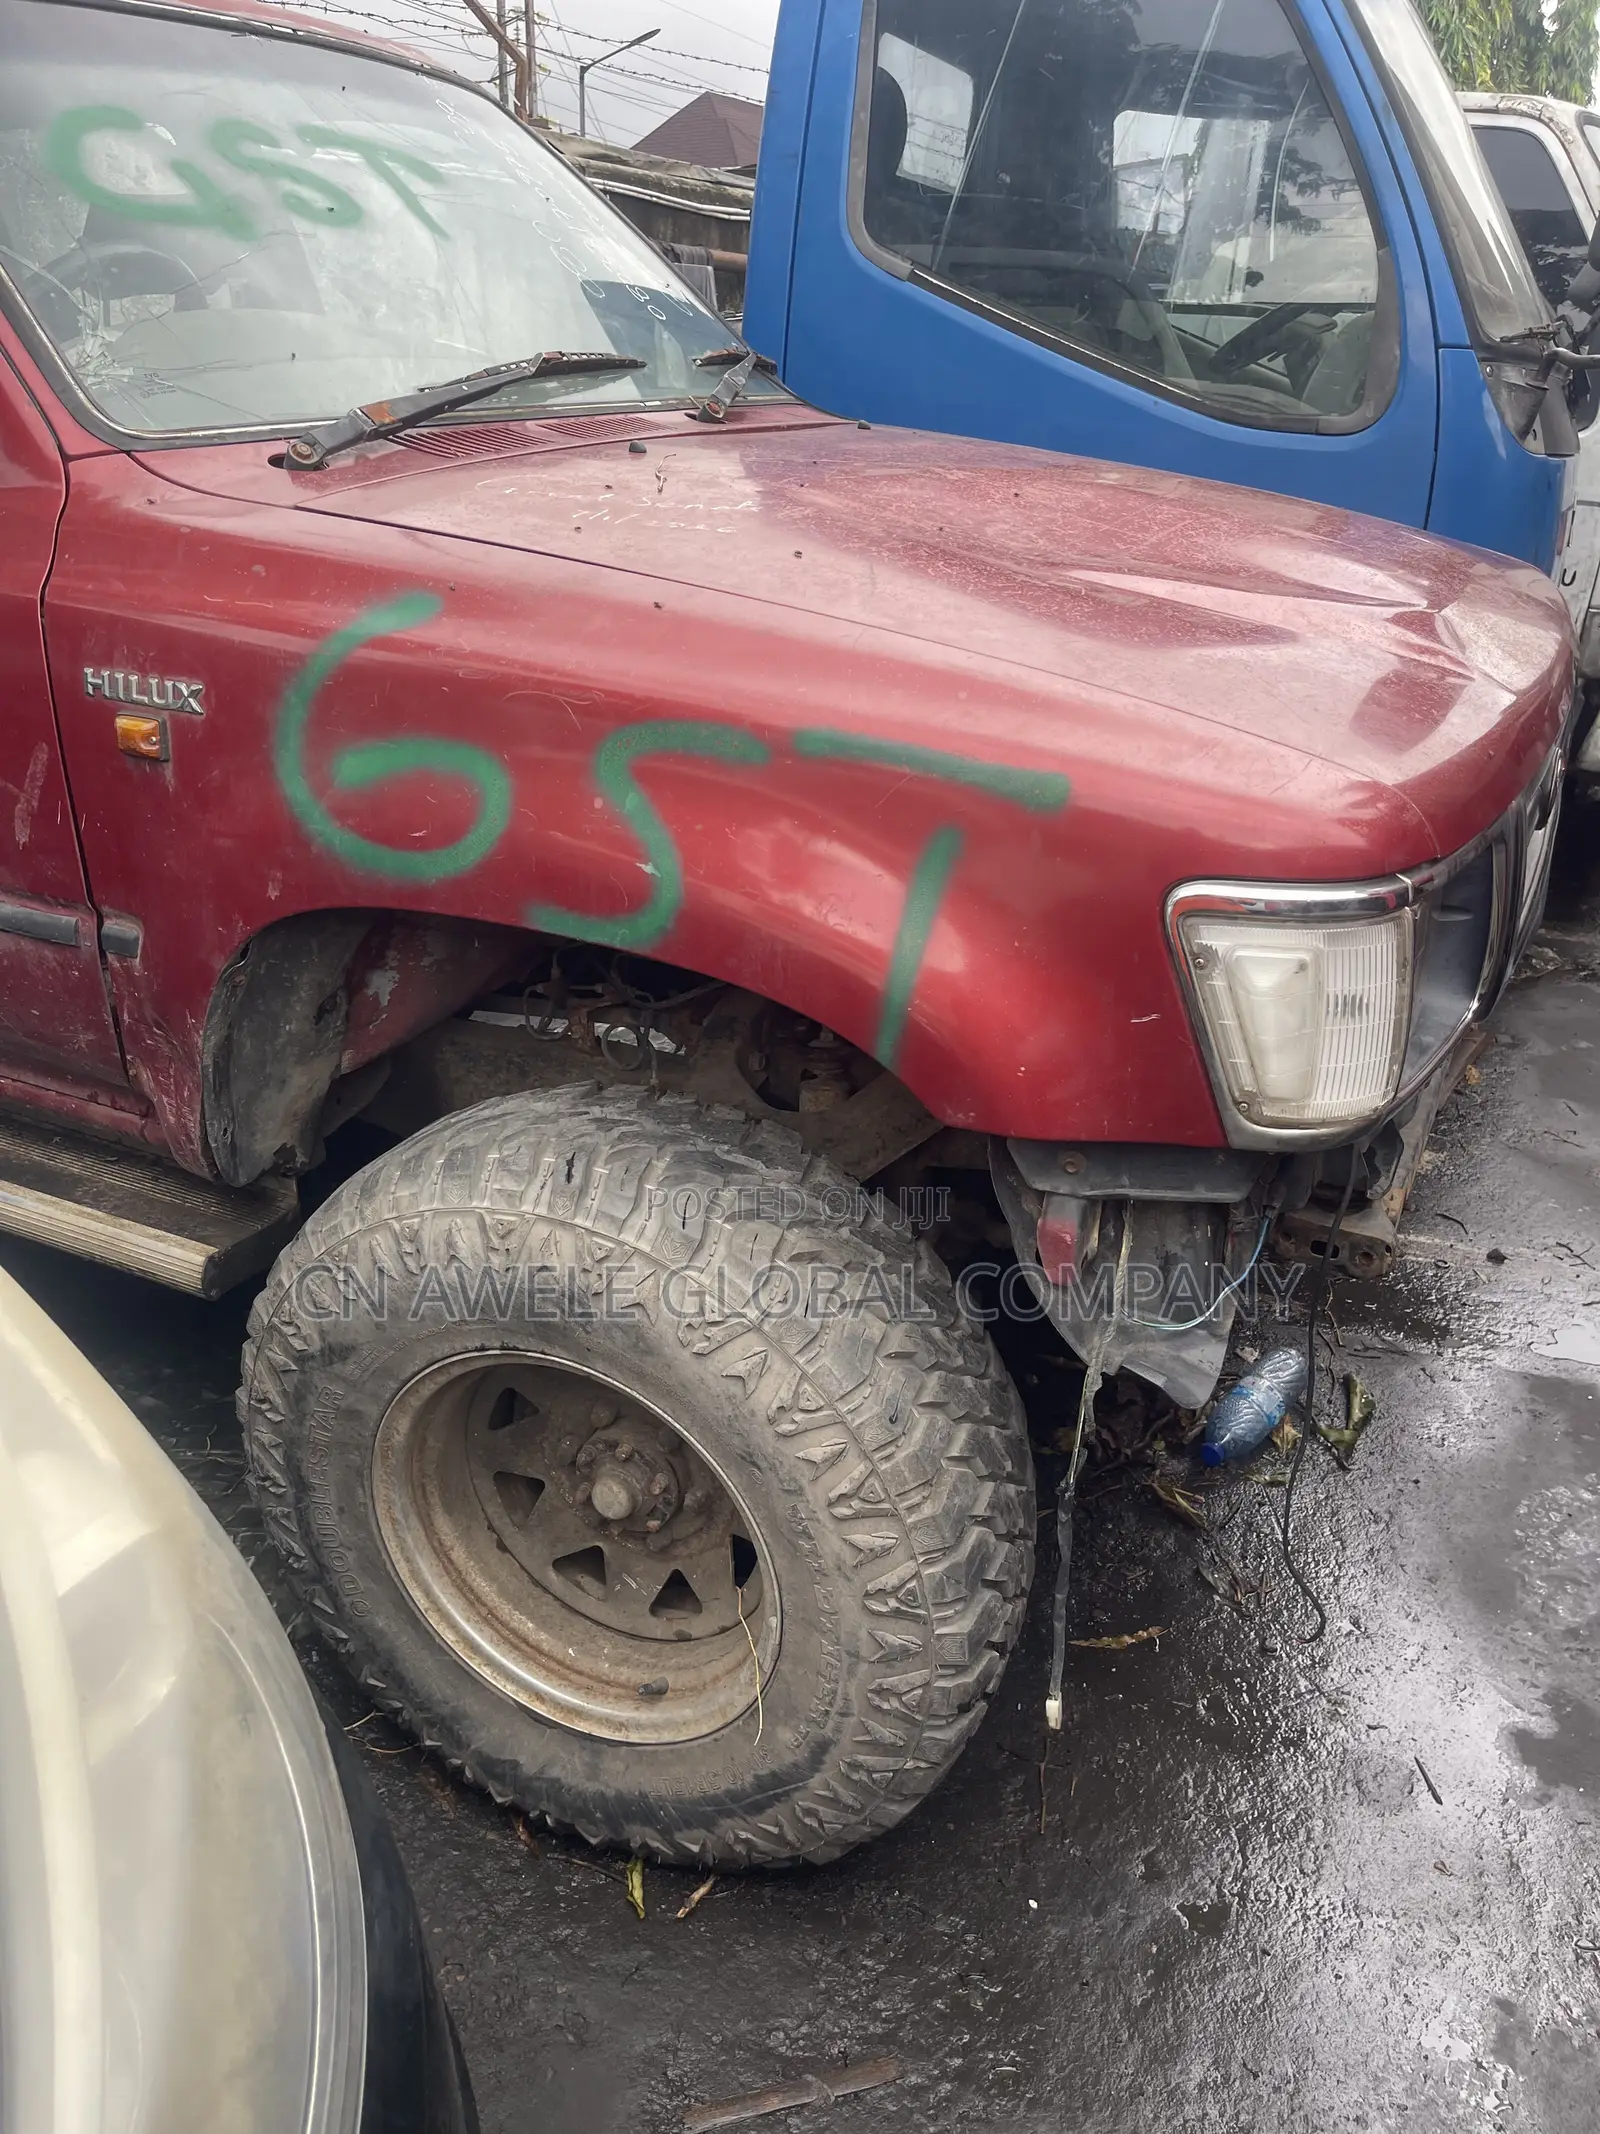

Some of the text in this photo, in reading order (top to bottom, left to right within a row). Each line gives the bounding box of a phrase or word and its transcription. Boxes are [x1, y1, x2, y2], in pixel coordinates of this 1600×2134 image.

[48, 104, 450, 242] GST
[84, 667, 204, 715] HILUX
[275, 592, 1072, 1068] GST
[308, 1385, 365, 1597] DOUBLESTAR
